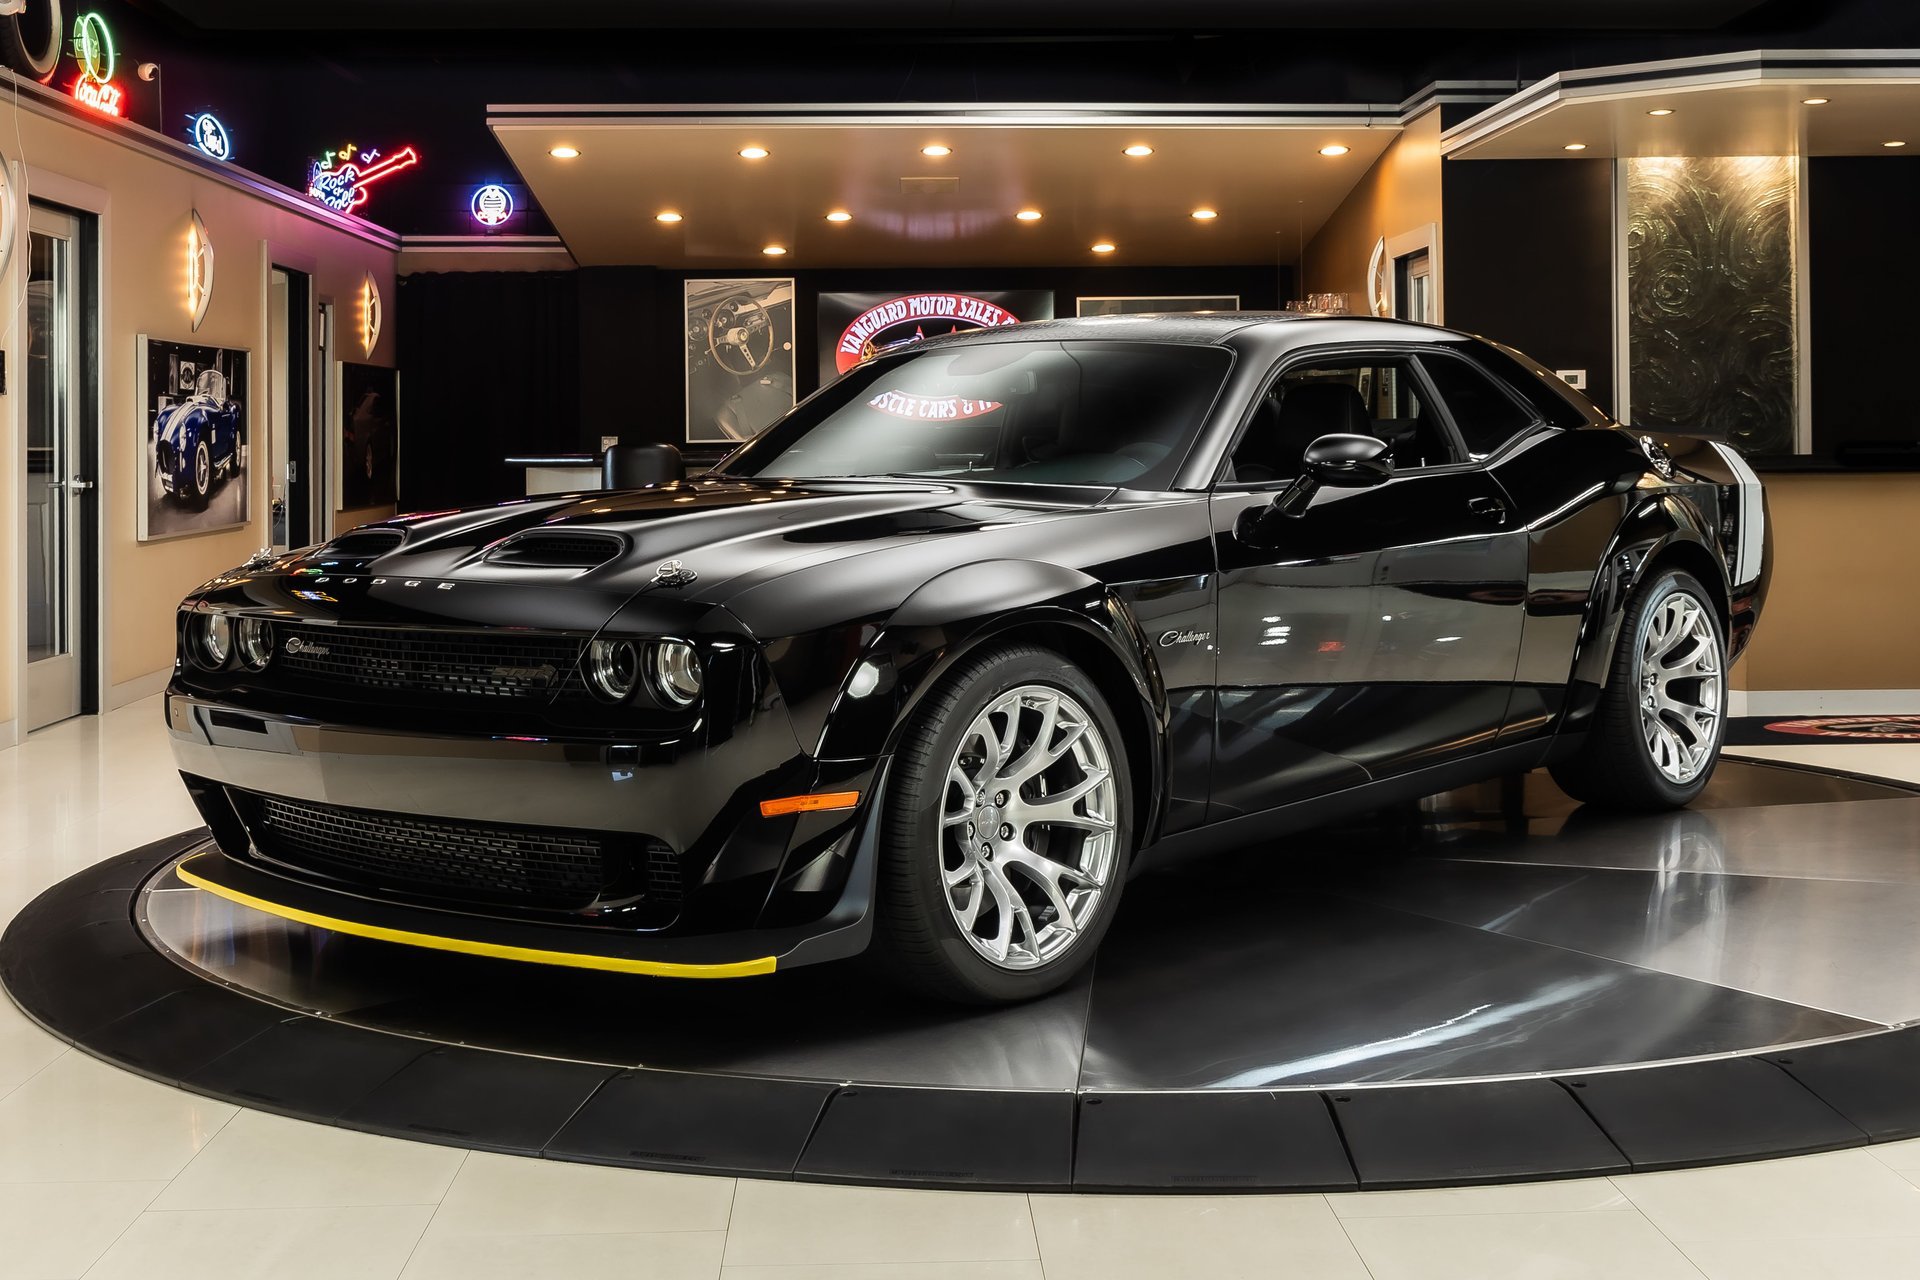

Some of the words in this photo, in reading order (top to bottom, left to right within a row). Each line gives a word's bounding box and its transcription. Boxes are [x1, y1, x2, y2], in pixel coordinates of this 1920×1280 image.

[319, 167, 355, 191] Rock
[841, 300, 907, 355] VANGUARD
[907, 296, 957, 316] MOTOR
[918, 399, 957, 418] CARS
[314, 577, 456, 590] DODGE
[1159, 630, 1210, 647] Challenger
